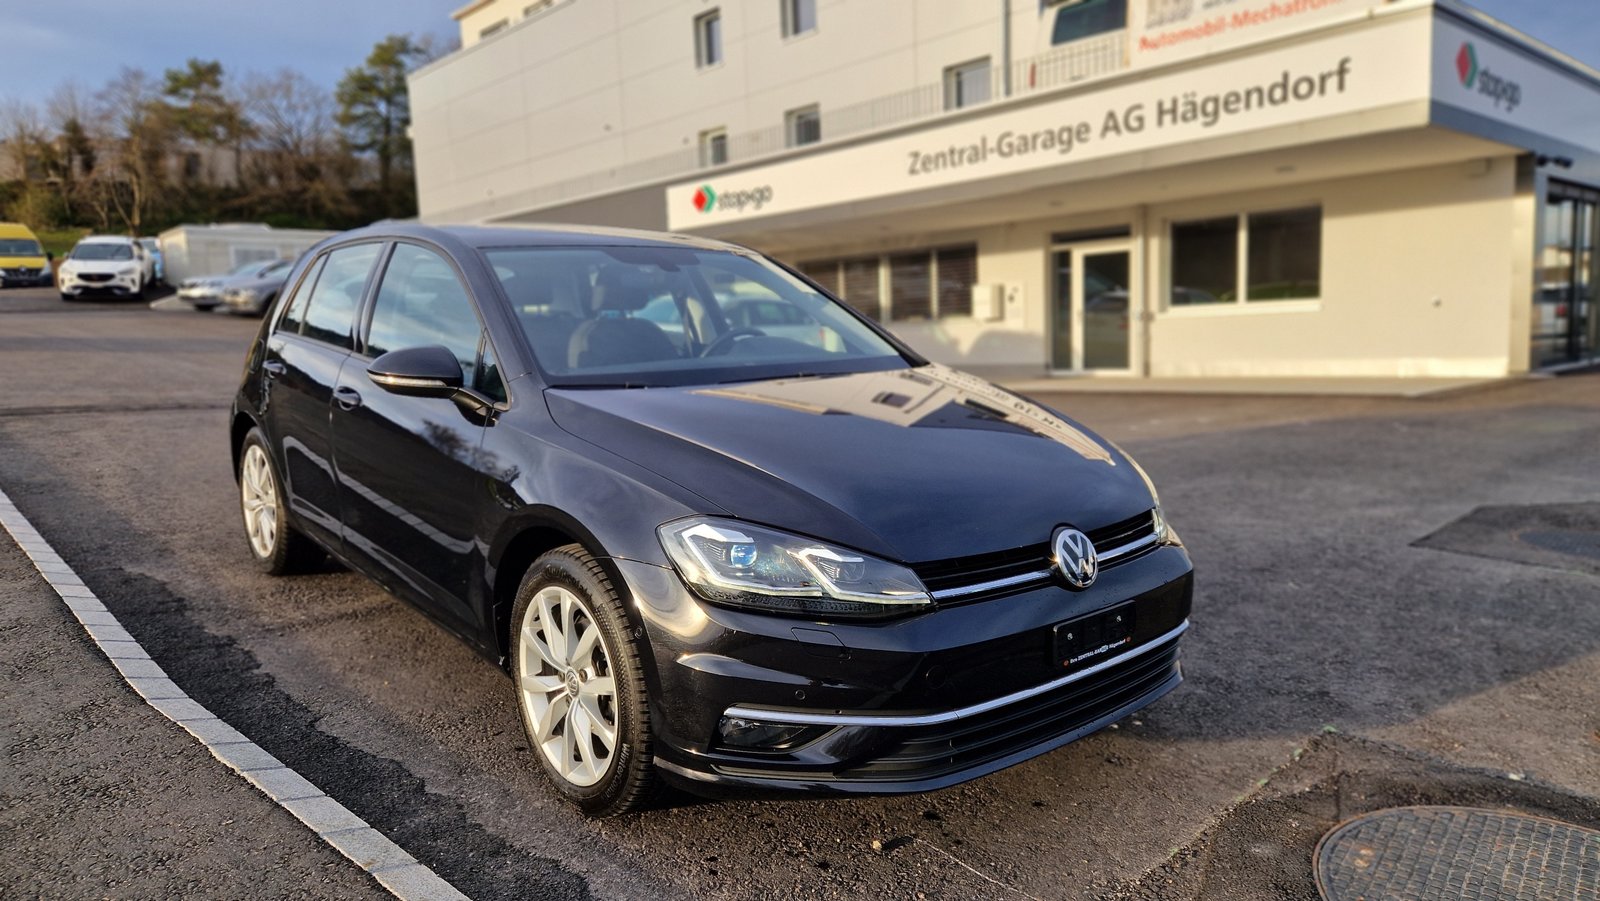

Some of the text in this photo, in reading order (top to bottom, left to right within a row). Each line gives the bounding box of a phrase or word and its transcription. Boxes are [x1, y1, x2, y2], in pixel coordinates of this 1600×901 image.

[907, 56, 1352, 176] Zentral-Garage AG Hägendorf
